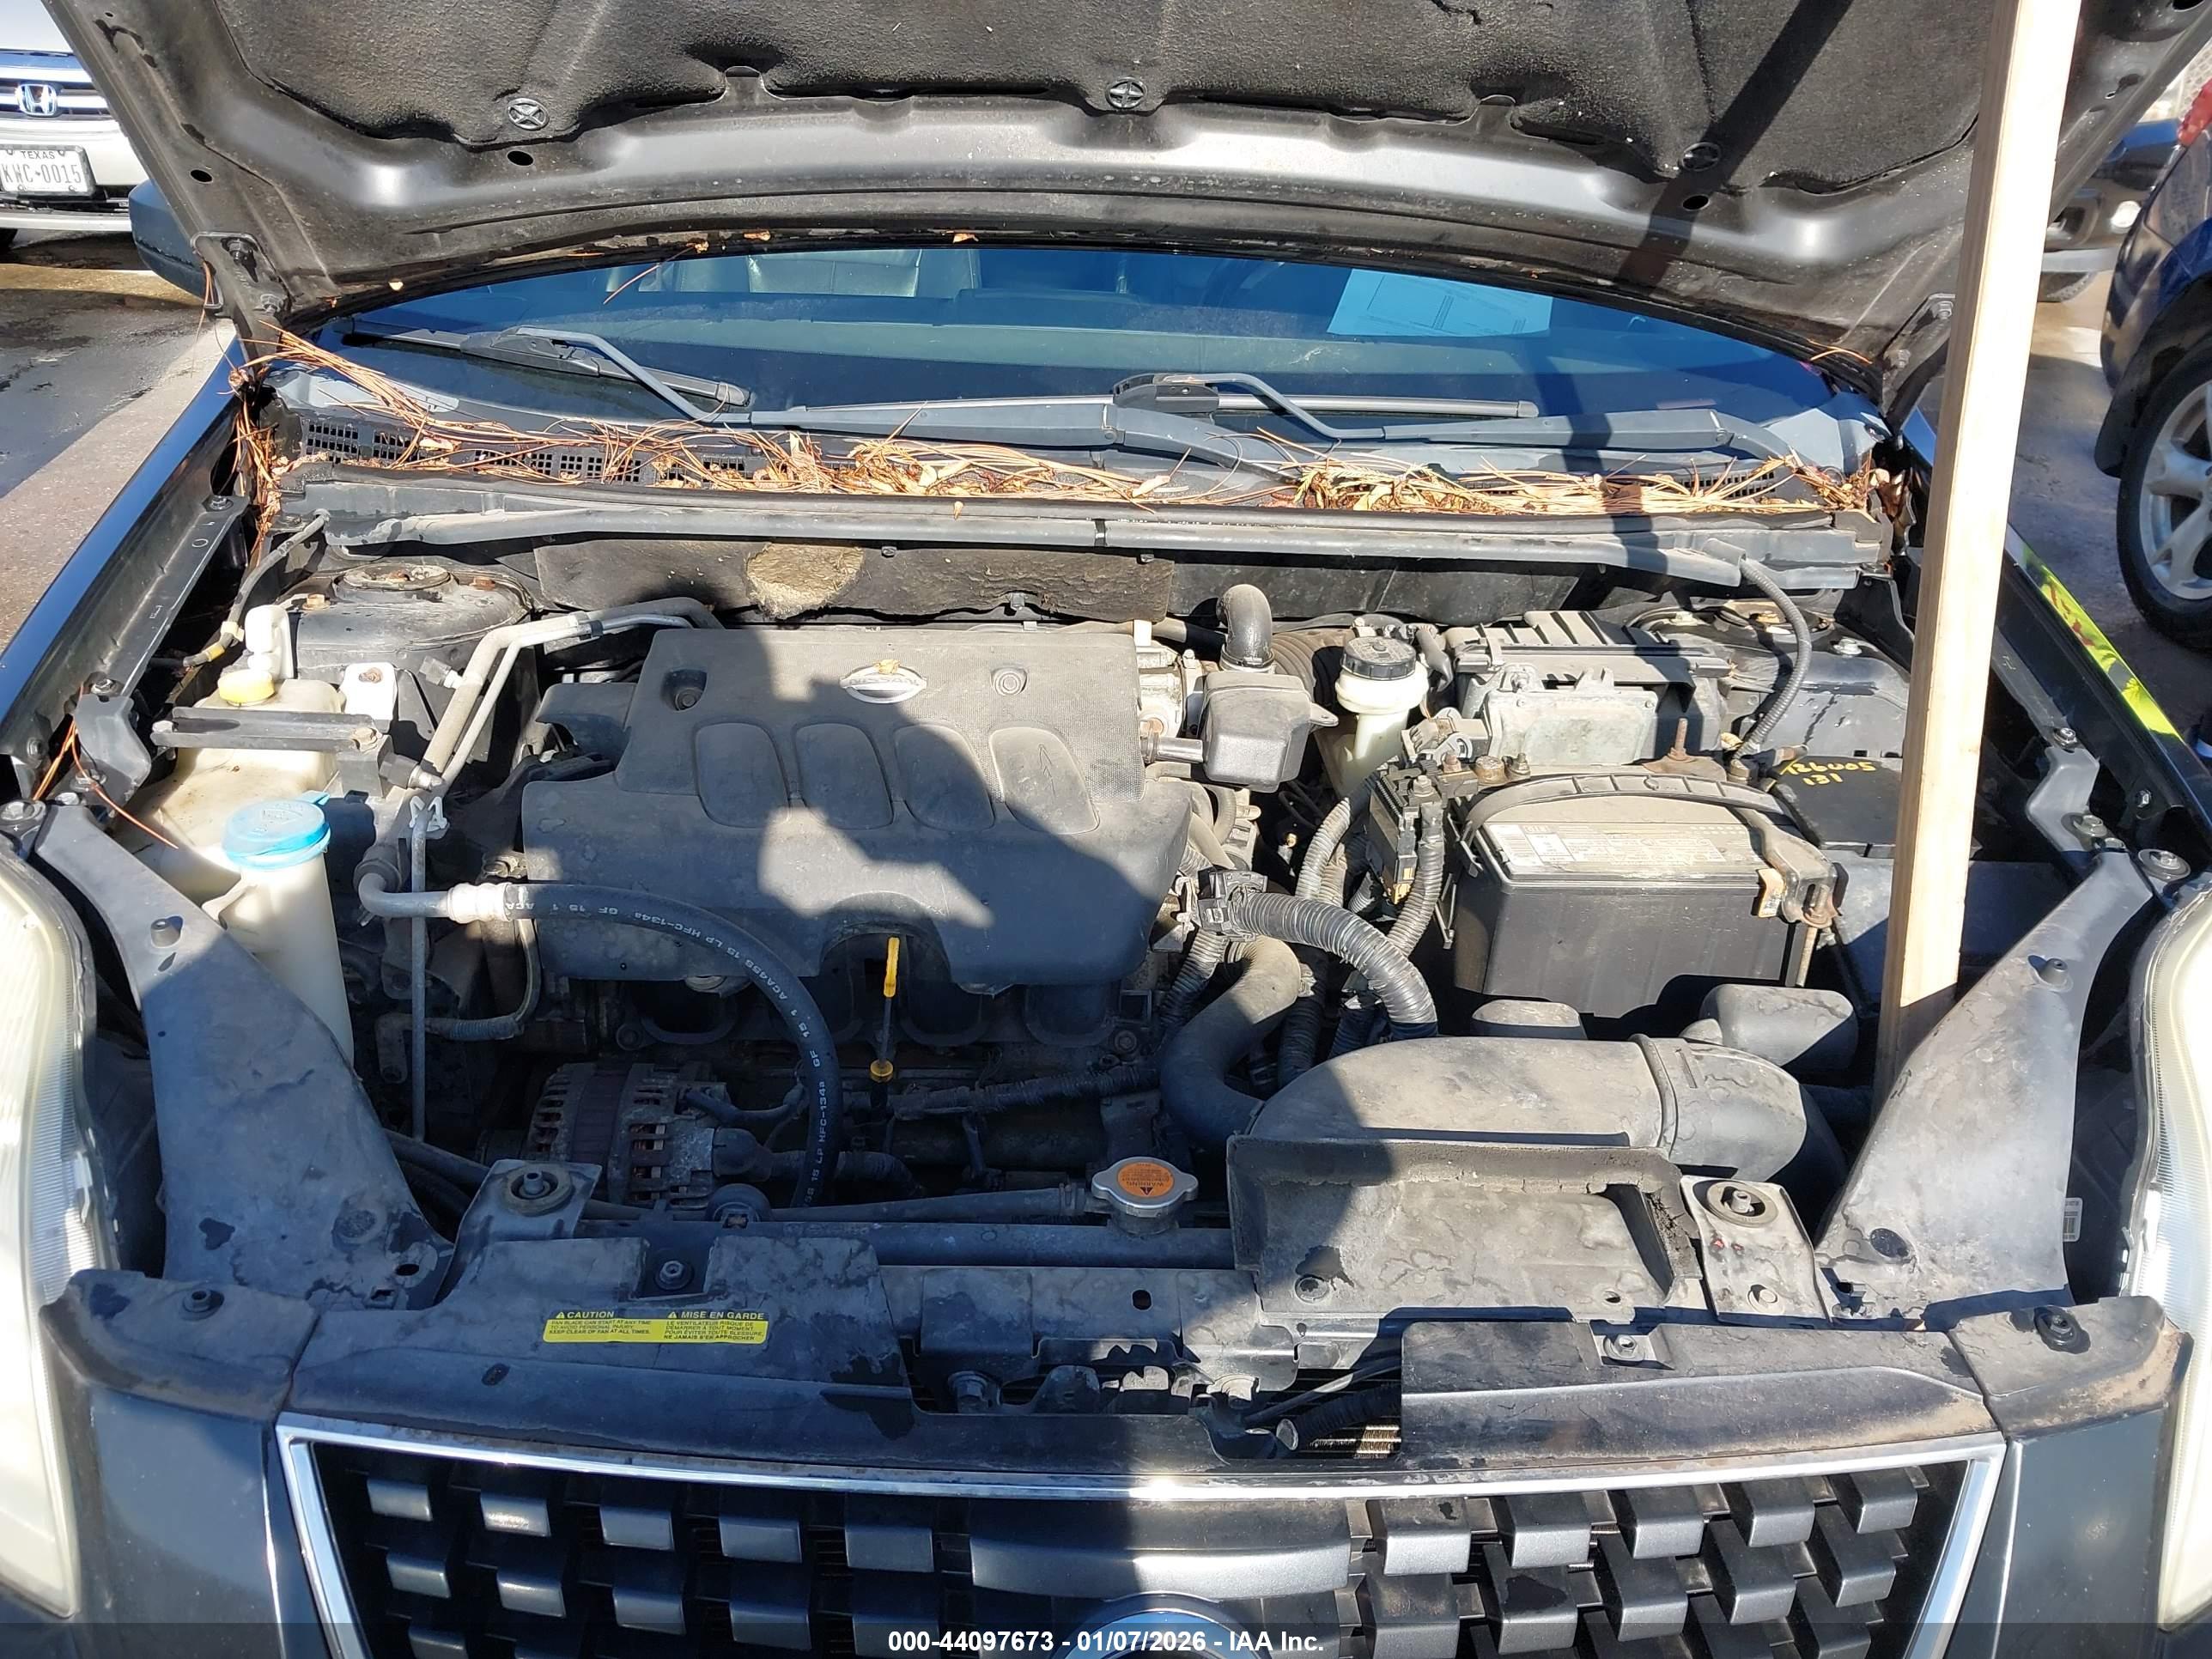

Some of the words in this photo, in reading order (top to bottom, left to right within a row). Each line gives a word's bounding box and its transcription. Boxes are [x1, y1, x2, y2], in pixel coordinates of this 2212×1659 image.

[21, 150, 56, 160] TEXAS
[598, 906, 618, 915] GF
[635, 912, 702, 938] HFC-134a
[705, 936, 723, 948] LP
[810, 1050, 821, 1067] GF
[726, 1311, 764, 1320] GARDE
